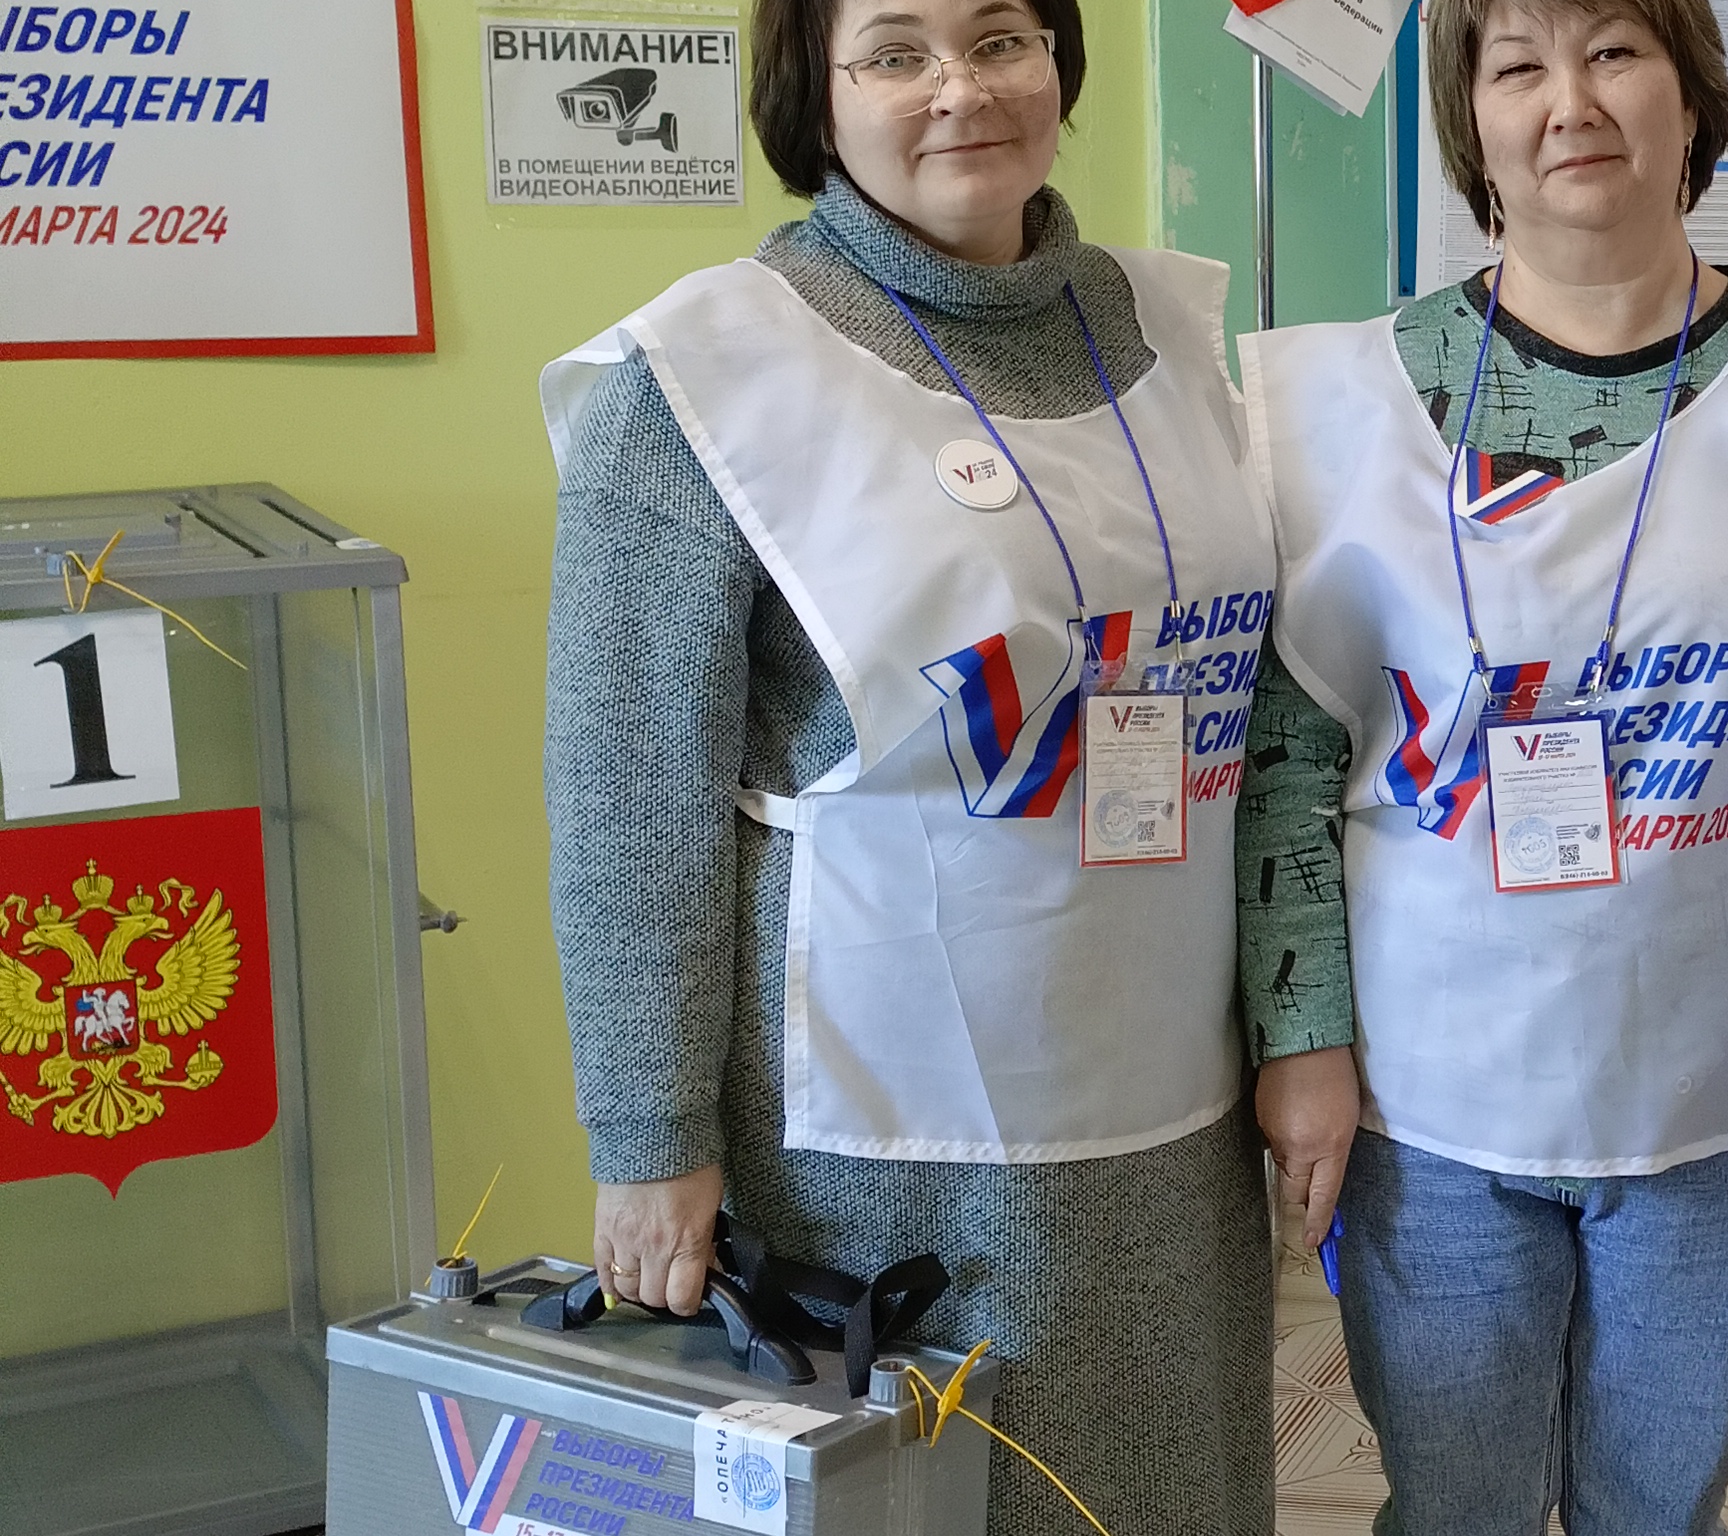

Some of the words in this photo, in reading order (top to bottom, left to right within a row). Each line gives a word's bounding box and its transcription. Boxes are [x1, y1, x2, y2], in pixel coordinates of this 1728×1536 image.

[0, 6, 190, 55] БОРЫ
[493, 30, 731, 65] ВНИМАНИЕ!
[0, 73, 269, 129] ЗИДЕНТА
[0, 141, 116, 187] СИИ
[499, 159, 511, 173] В
[518, 159, 644, 175] ПОМЕЩЕНИИ
[651, 155, 735, 176] ВЕДЁТСЯ
[500, 179, 736, 199] ВИДЕОНАБЛЮДЕНИЕ
[127, 205, 228, 245] 2024
[1155, 590, 1274, 649] ВЫБОР
[33, 632, 137, 789] 1
[1618, 759, 1714, 800] СИИ
[552, 1429, 665, 1478] ВЫБОРЫ
[538, 1460, 694, 1523] ПРЕЗИДЕНТА
